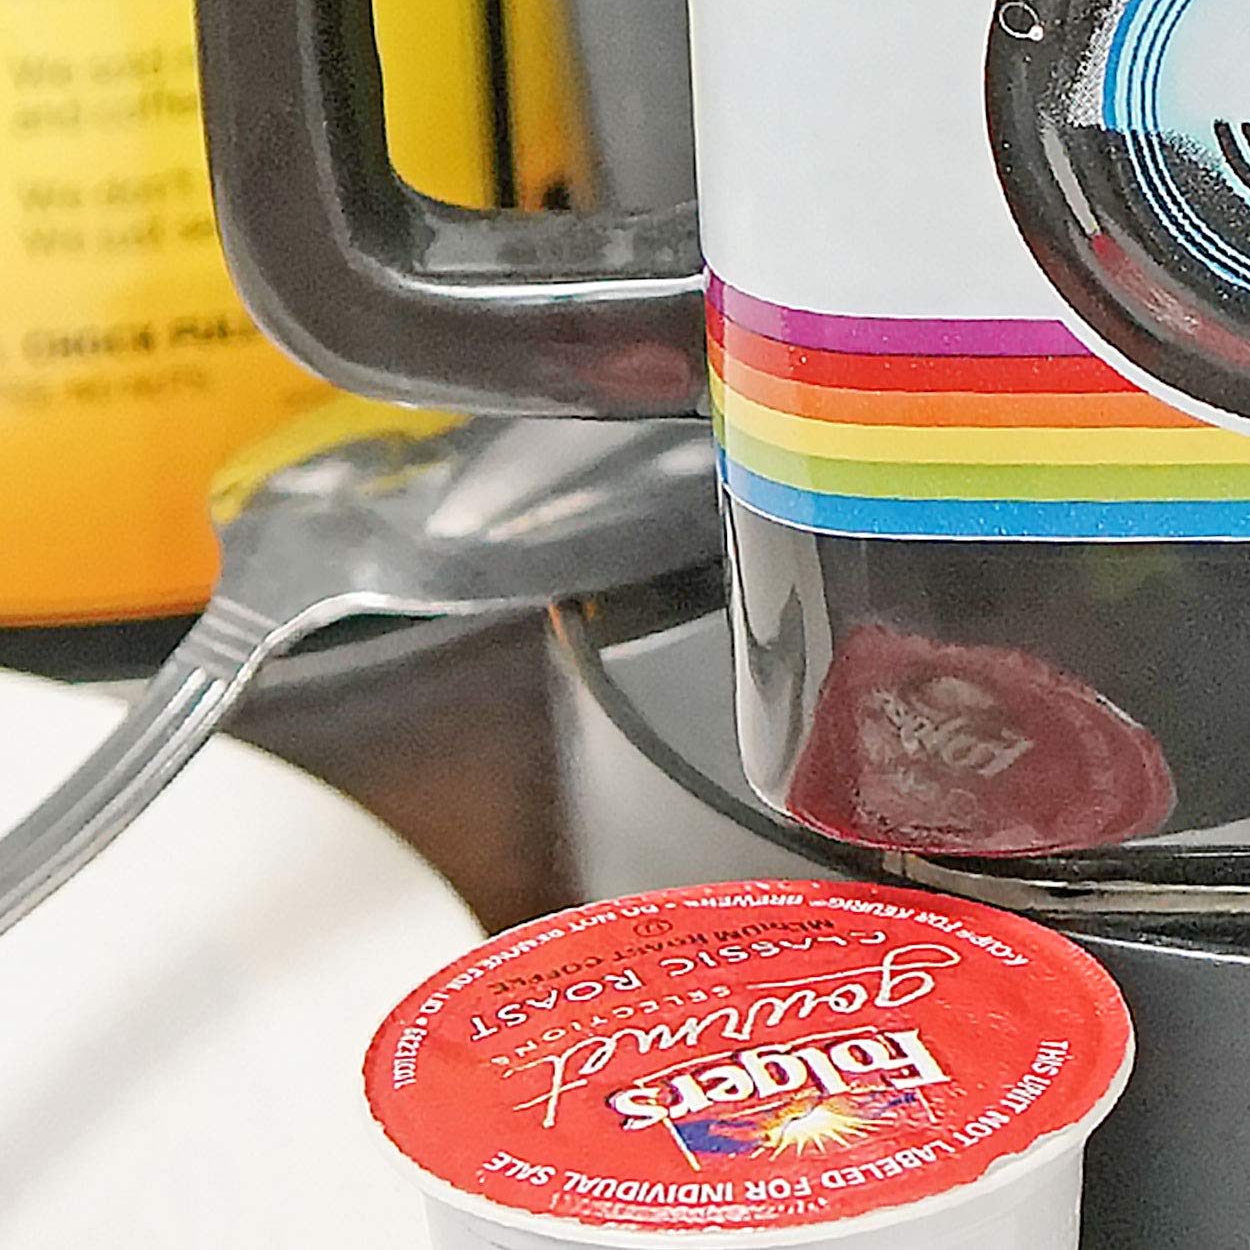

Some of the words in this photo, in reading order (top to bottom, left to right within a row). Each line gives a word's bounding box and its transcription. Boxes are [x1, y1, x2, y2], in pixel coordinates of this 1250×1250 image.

[568, 911, 618, 933] NOT
[620, 904, 660, 918] DO
[914, 910, 963, 934] FOR
[613, 933, 709, 963] ROAST
[714, 918, 834, 943] MEDIUM
[659, 930, 887, 977] CLASSIC
[485, 955, 603, 995] COFFEE
[419, 991, 450, 1015] LID
[469, 968, 644, 1042] ROAST
[490, 984, 732, 1070] SELECTIONS
[501, 944, 963, 1129] gourmet
[1029, 1039, 1072, 1077] THIS
[610, 1027, 951, 1132] Folgers
[999, 1072, 1053, 1116] UNIT
[951, 1108, 1011, 1148] NOT
[482, 1151, 558, 1187] SALE
[819, 1139, 957, 1190] LABELED
[562, 1170, 735, 1204] INDIVIDUAL
[745, 1176, 813, 1201] FOR
